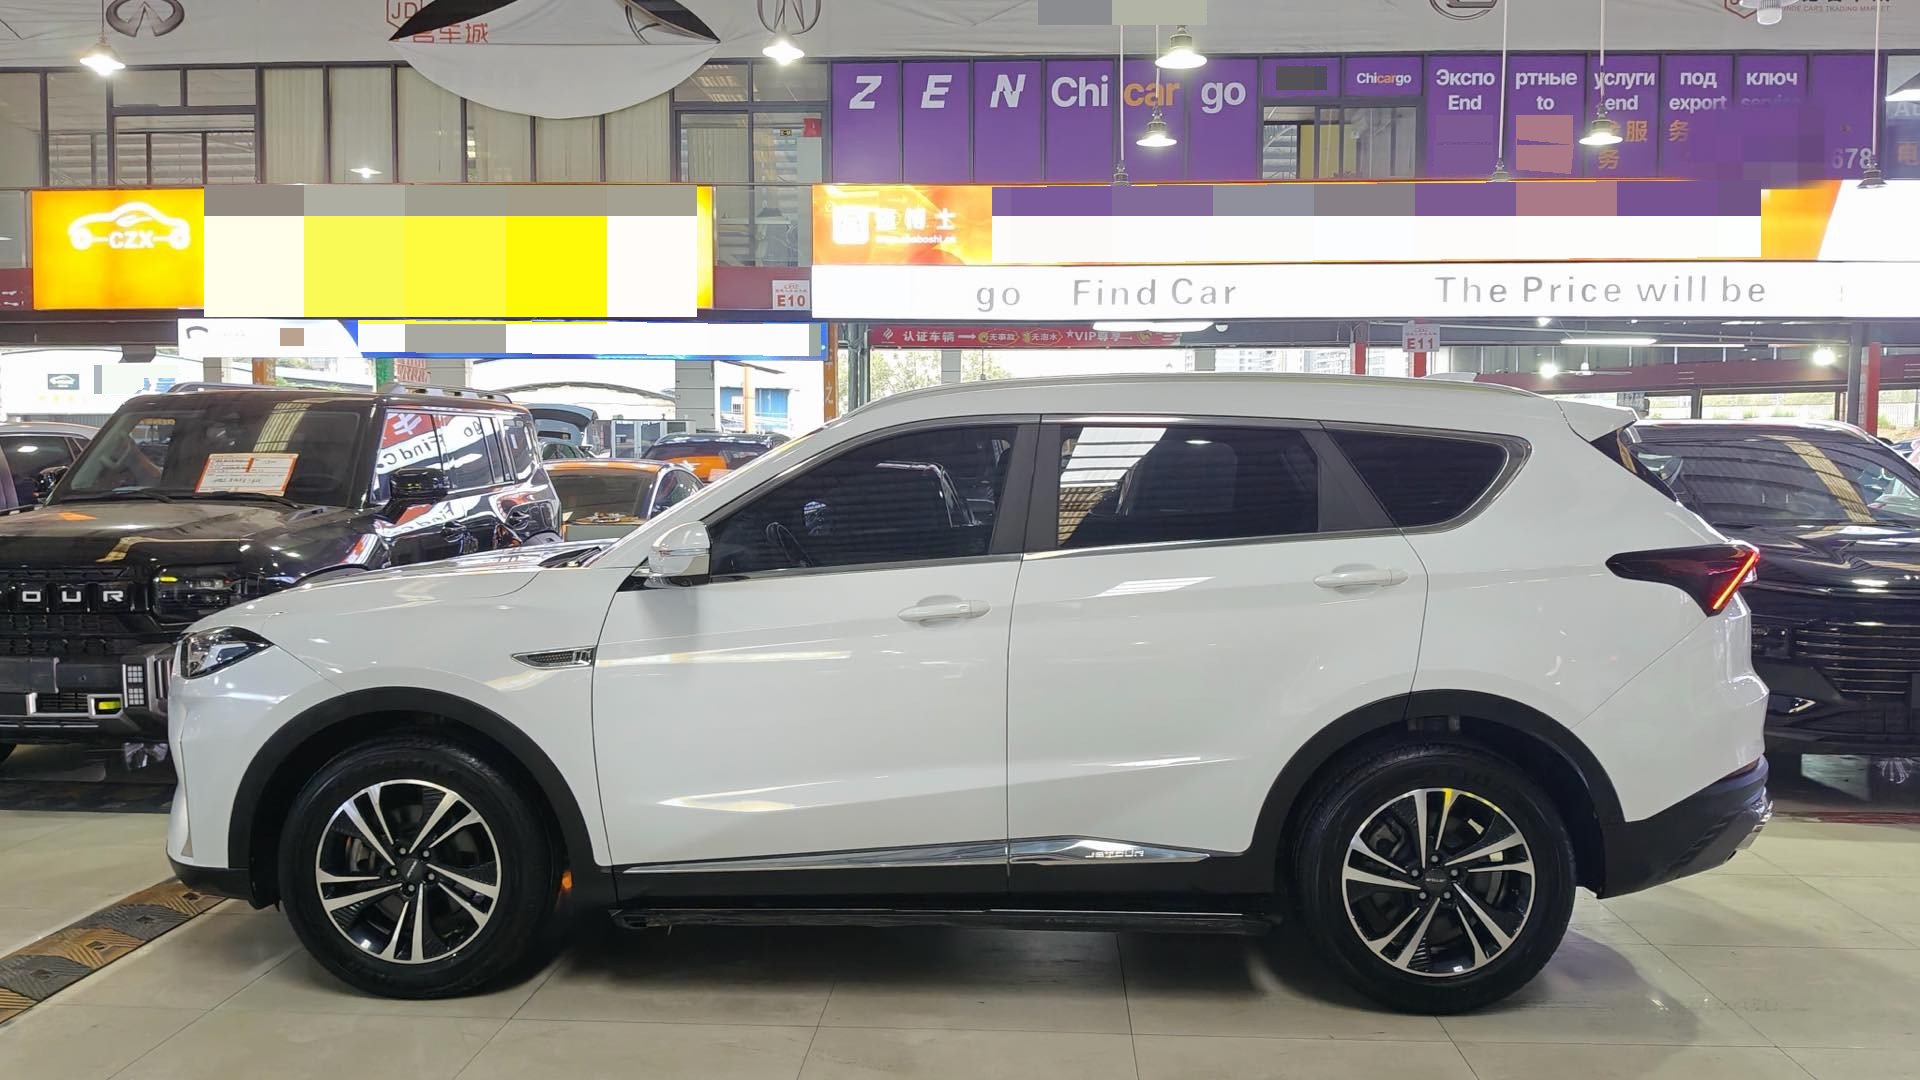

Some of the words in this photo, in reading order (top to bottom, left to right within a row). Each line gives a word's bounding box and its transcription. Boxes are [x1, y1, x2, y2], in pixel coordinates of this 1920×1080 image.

[1356, 72, 1412, 86] Chicargo
[1436, 69, 1495, 86] Экспо
[1515, 72, 1577, 89] ртные
[1594, 72, 1655, 89] услуги
[1680, 72, 1717, 88] под
[1746, 72, 1798, 86] ключ
[1201, 81, 1246, 113] go
[1448, 95, 1482, 110] End
[1536, 96, 1555, 110] to
[1604, 95, 1639, 111] end
[1669, 95, 1727, 113] export
[109, 230, 154, 249] CZX
[976, 286, 1021, 312] go
[1074, 279, 1156, 306] Find
[1172, 278, 1236, 304] Car
[1435, 276, 1507, 302] The
[1523, 276, 1621, 302] Price
[1637, 276, 1707, 302] will
[1722, 276, 1766, 302] be
[777, 295, 805, 307] E10
[1407, 338, 1433, 349] E11
